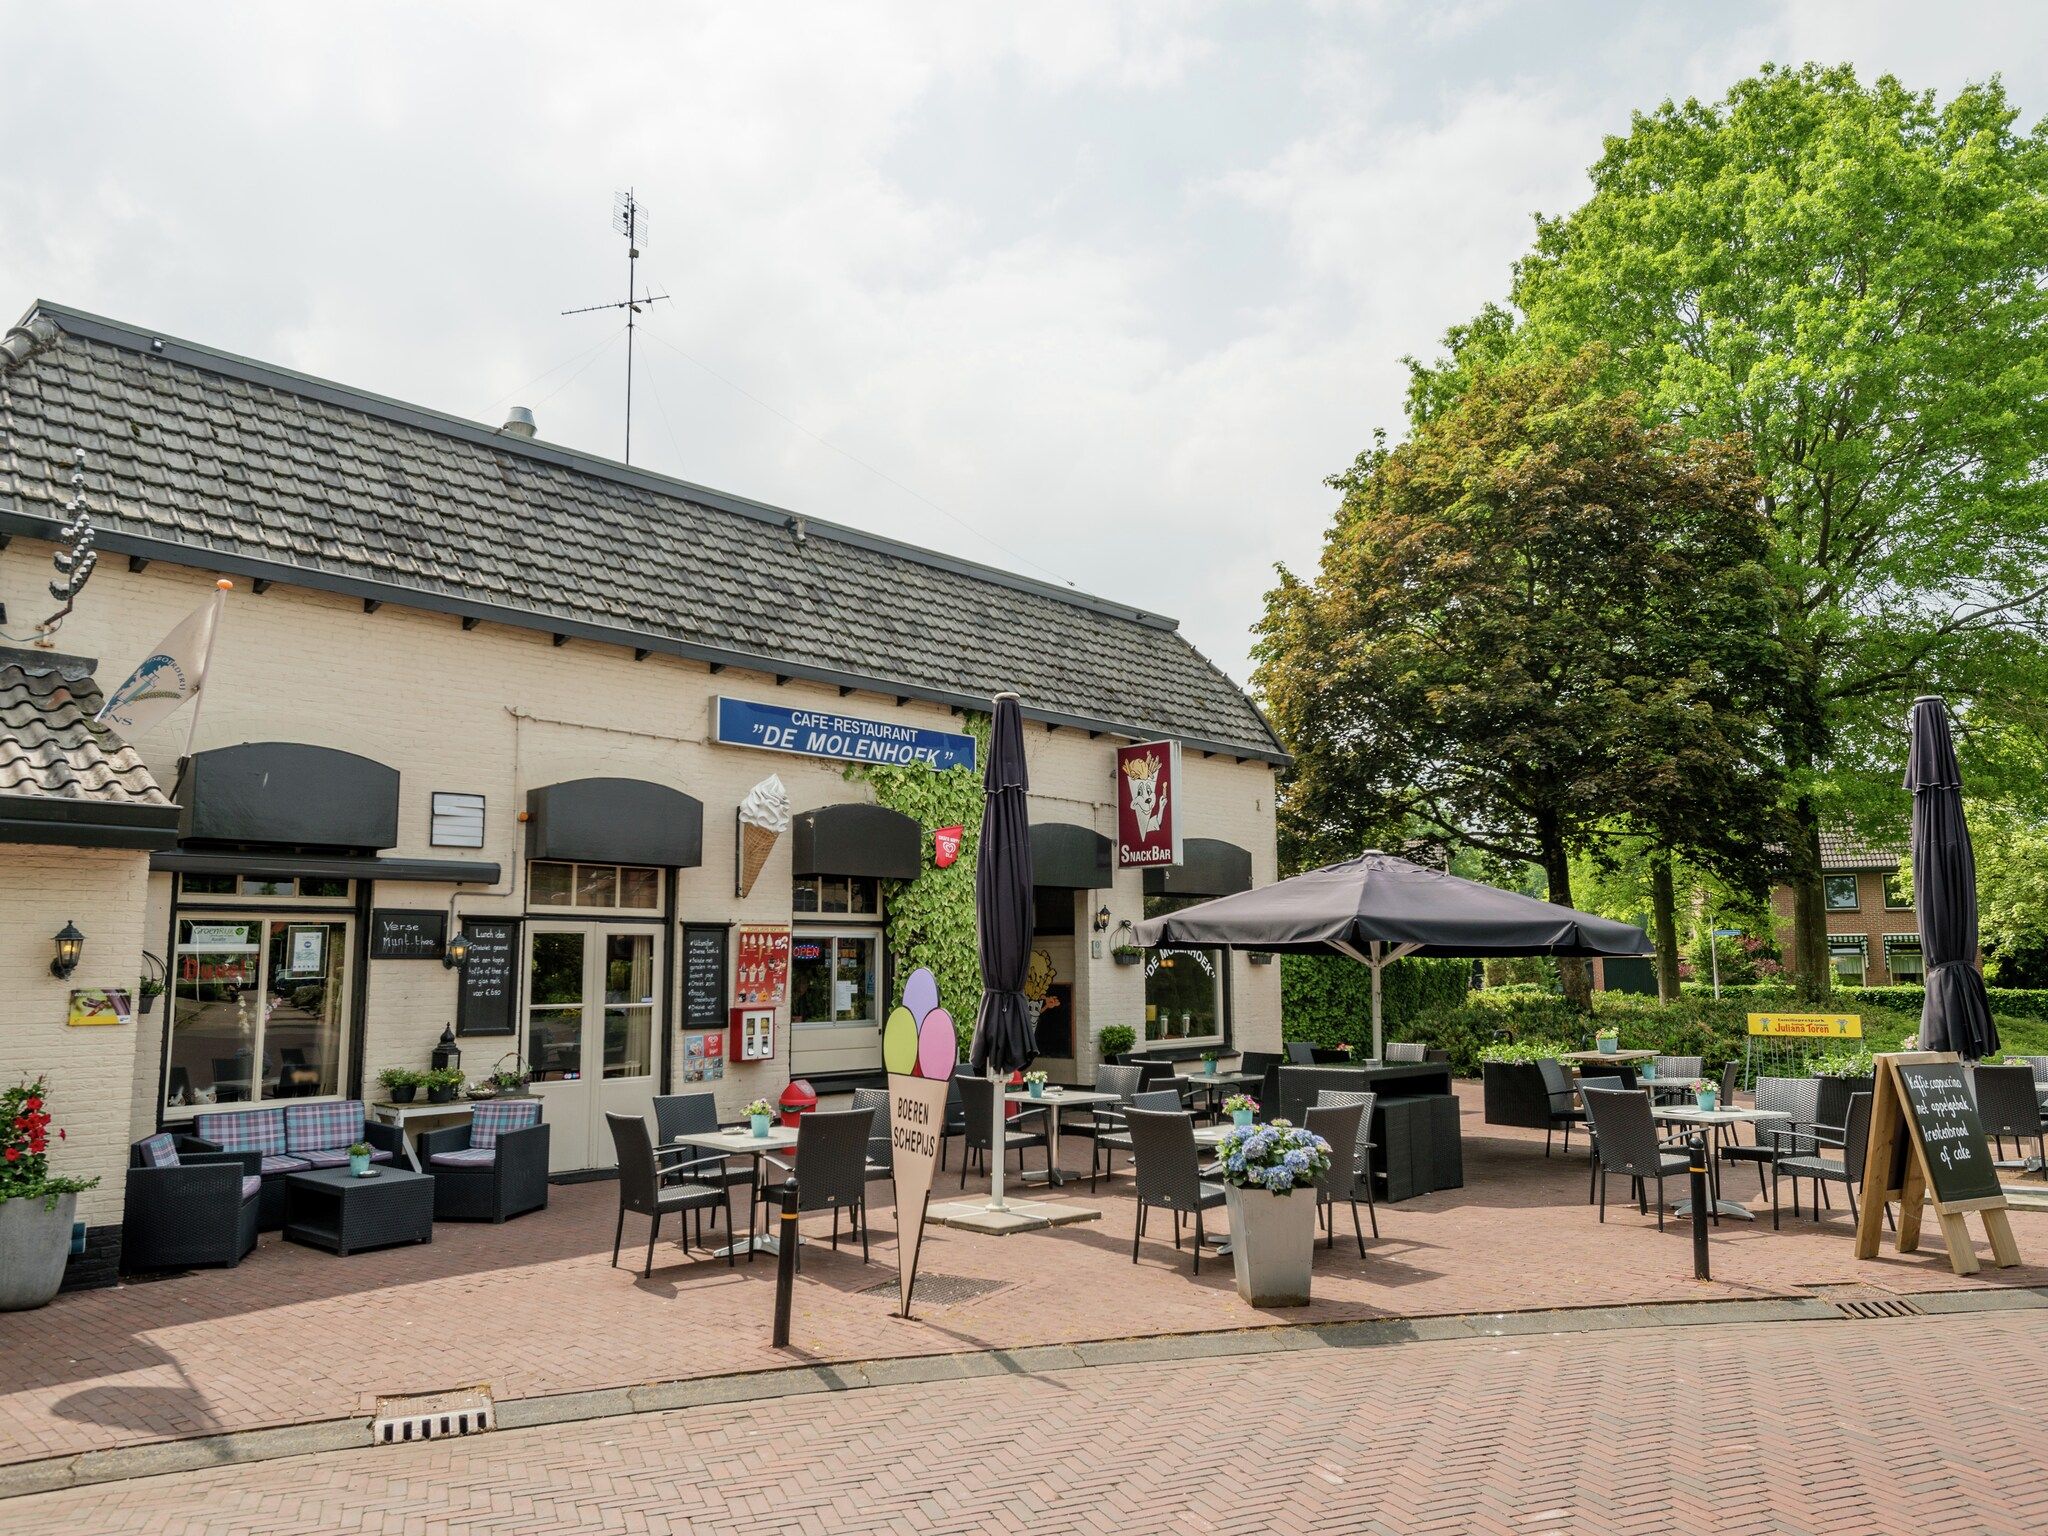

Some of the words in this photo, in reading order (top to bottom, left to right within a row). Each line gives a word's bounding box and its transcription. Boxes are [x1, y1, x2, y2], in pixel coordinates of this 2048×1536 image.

[791, 711, 918, 743] CAFE-RESTAURANT
[383, 921, 419, 931] Verse
[475, 928, 494, 939] Lunch
[793, 947, 820, 957] OPEN
[1774, 1022, 1805, 1033] Juliana
[1806, 1023, 1830, 1034] Toren
[897, 1096, 930, 1126] BOEREN
[1915, 1099, 1930, 1115] met
[893, 1126, 936, 1158] SCHEPIJS
[1940, 1145, 1953, 1170] of
[1953, 1140, 1972, 1160] cake
